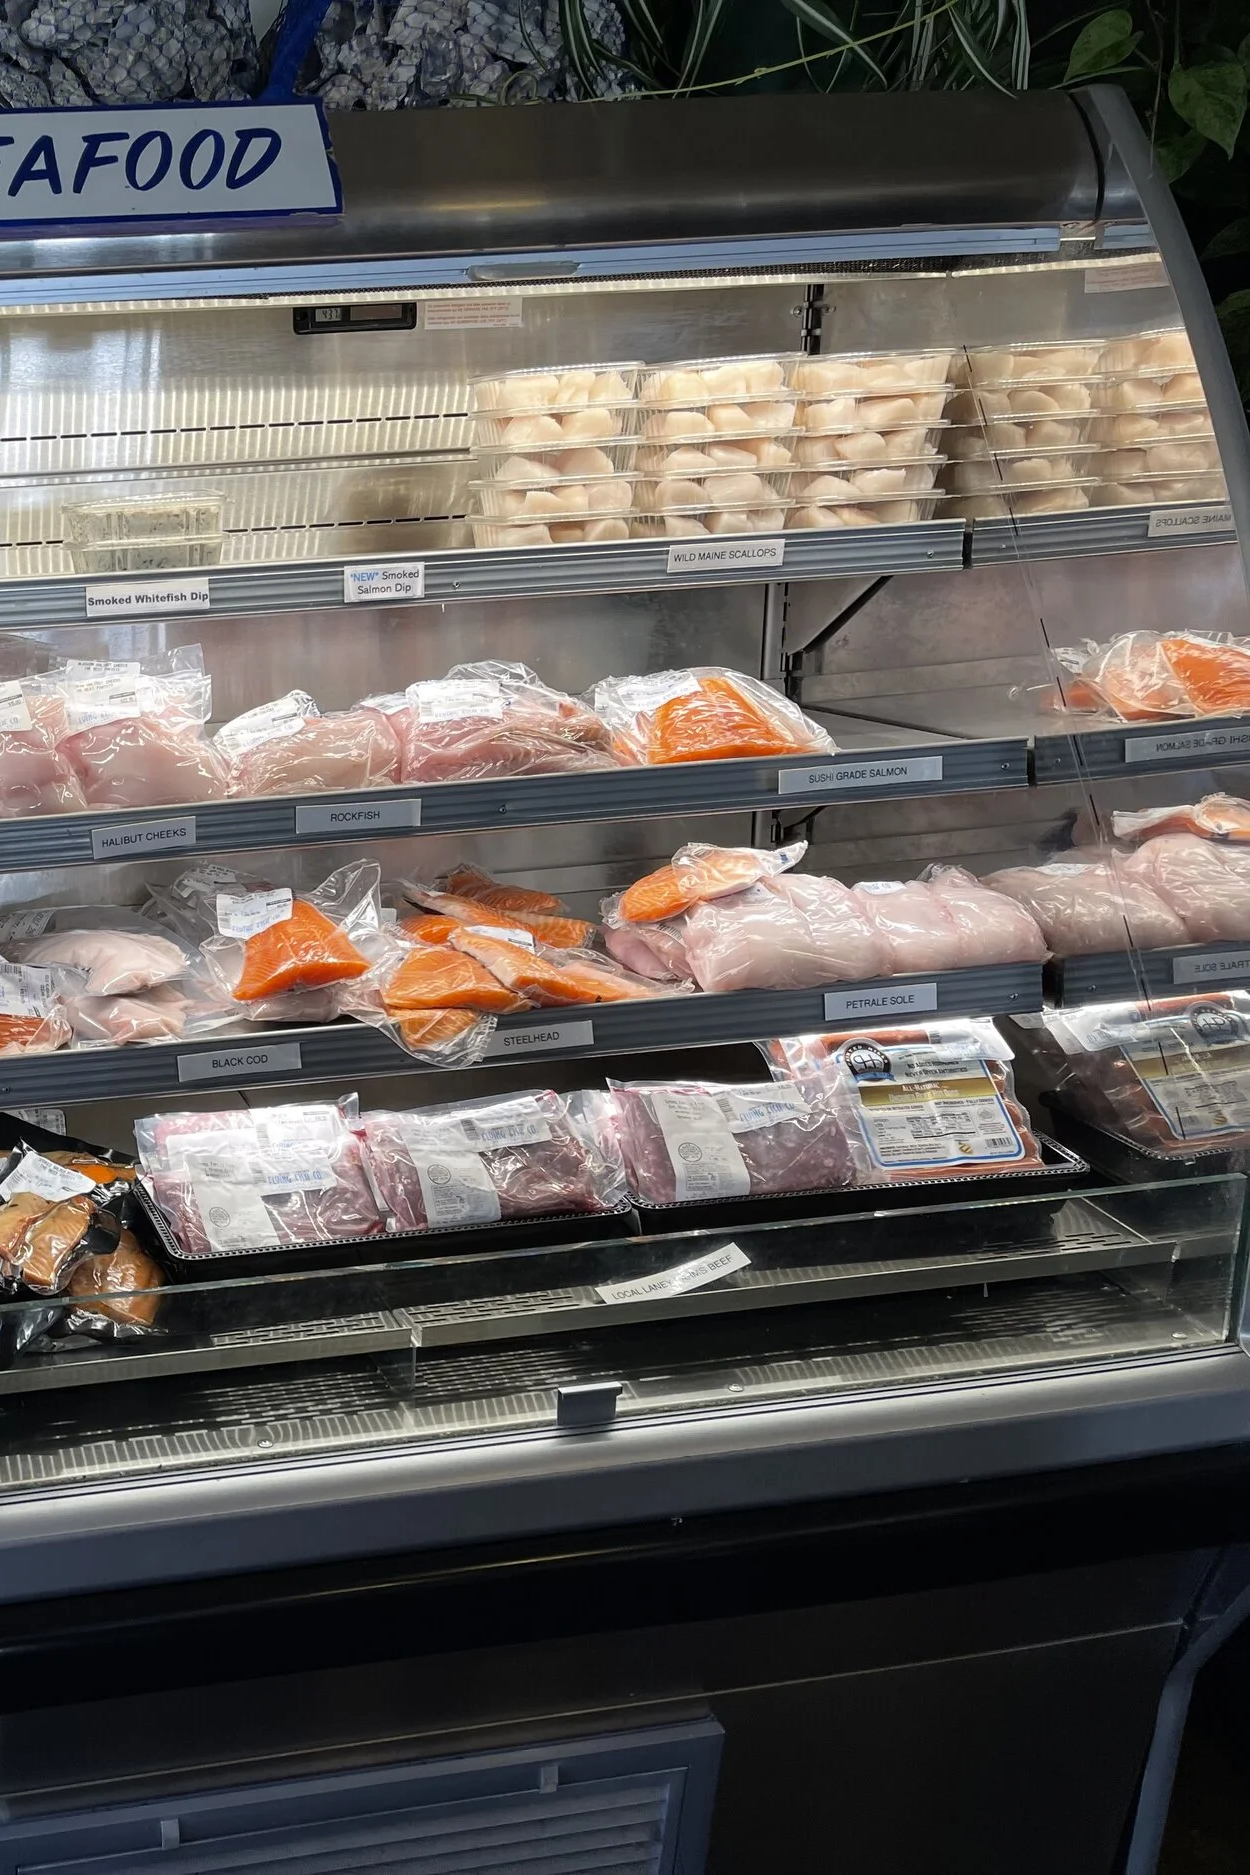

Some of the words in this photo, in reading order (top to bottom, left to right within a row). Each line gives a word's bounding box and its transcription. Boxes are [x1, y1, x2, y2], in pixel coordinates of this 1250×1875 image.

[673, 553, 696, 562] WILD
[698, 551, 726, 560] MAINE
[728, 548, 777, 559] SCALLOPS
[382, 569, 420, 580] Smoked
[357, 584, 392, 595] Salmon
[394, 583, 412, 594] Dip
[88, 595, 131, 606] Smoked
[134, 592, 187, 605] Whitefish
[190, 591, 209, 604] Dip
[809, 773, 834, 784] SUSHI
[836, 770, 867, 781] GRADE
[869, 767, 908, 778] SALMON
[330, 811, 380, 822] ROCKFISH
[102, 833, 143, 847] HALIBUT
[146, 828, 187, 842] CHEEKS
[846, 997, 888, 1009] PETRALE
[890, 994, 915, 1006] SOLE
[503, 1031, 560, 1046] STEELHEAD
[212, 1057, 245, 1068] BLACK
[246, 1054, 269, 1066] COD
[611, 1288, 643, 1300] LOCAL
[642, 1278, 672, 1294] LANEY
[673, 1266, 708, 1285] ARMS
[707, 1254, 733, 1271] BEEF
